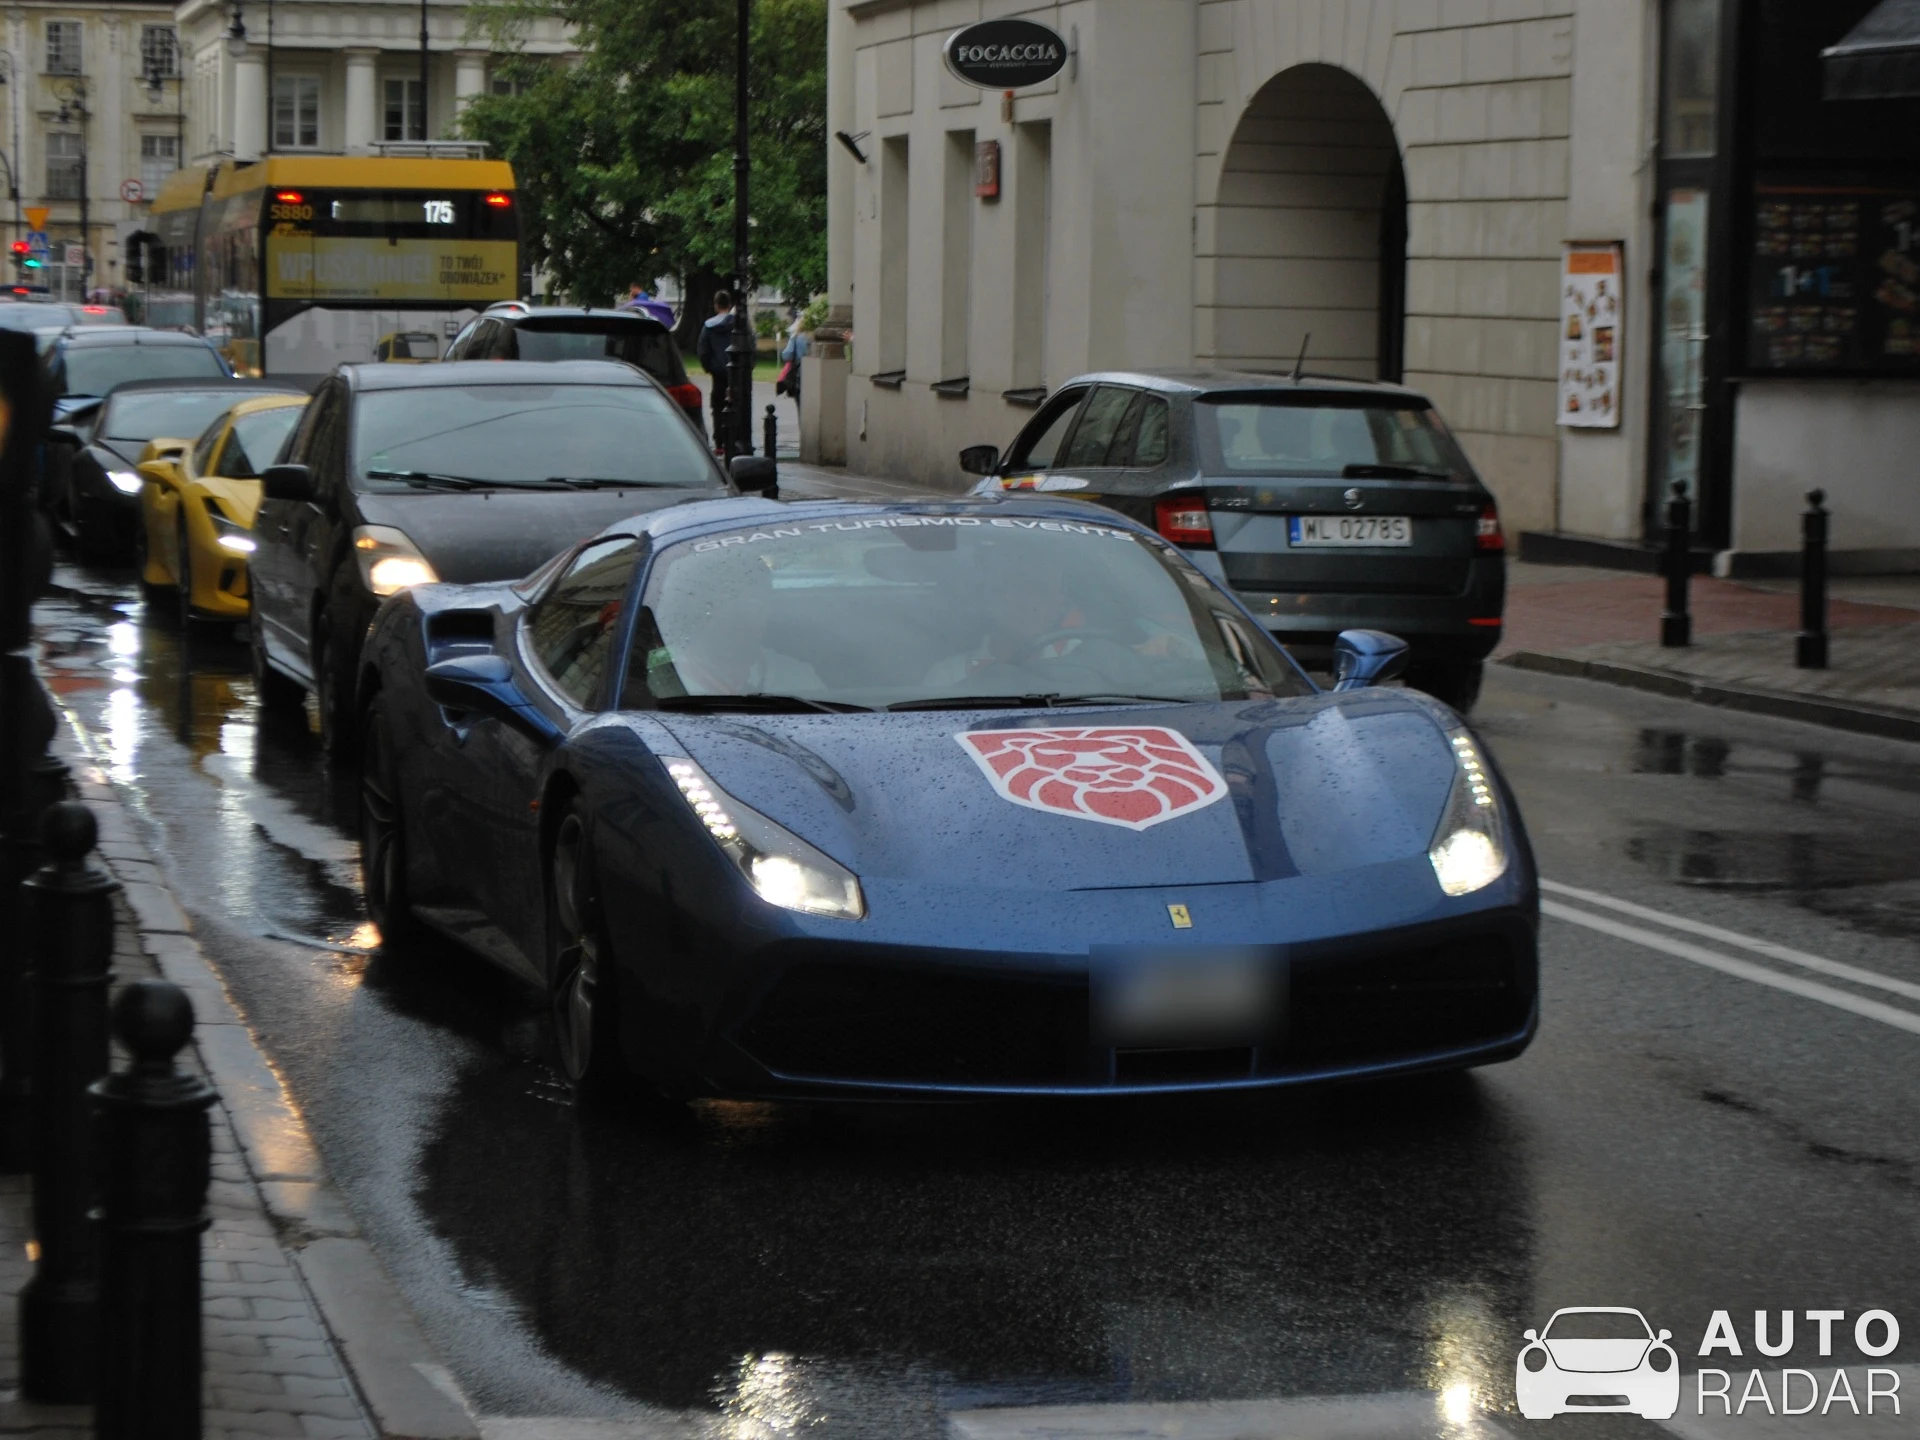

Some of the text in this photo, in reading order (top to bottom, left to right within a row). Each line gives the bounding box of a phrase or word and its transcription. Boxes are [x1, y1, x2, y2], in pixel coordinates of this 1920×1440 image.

[958, 43, 1059, 62] FOCACCIA
[270, 204, 313, 220] 5880
[423, 200, 456, 223] 175
[440, 252, 484, 271] TO TWÓJ
[694, 516, 1135, 553] GRAN TURISMO EVENTS
[1304, 519, 1404, 540] WL 0278S
